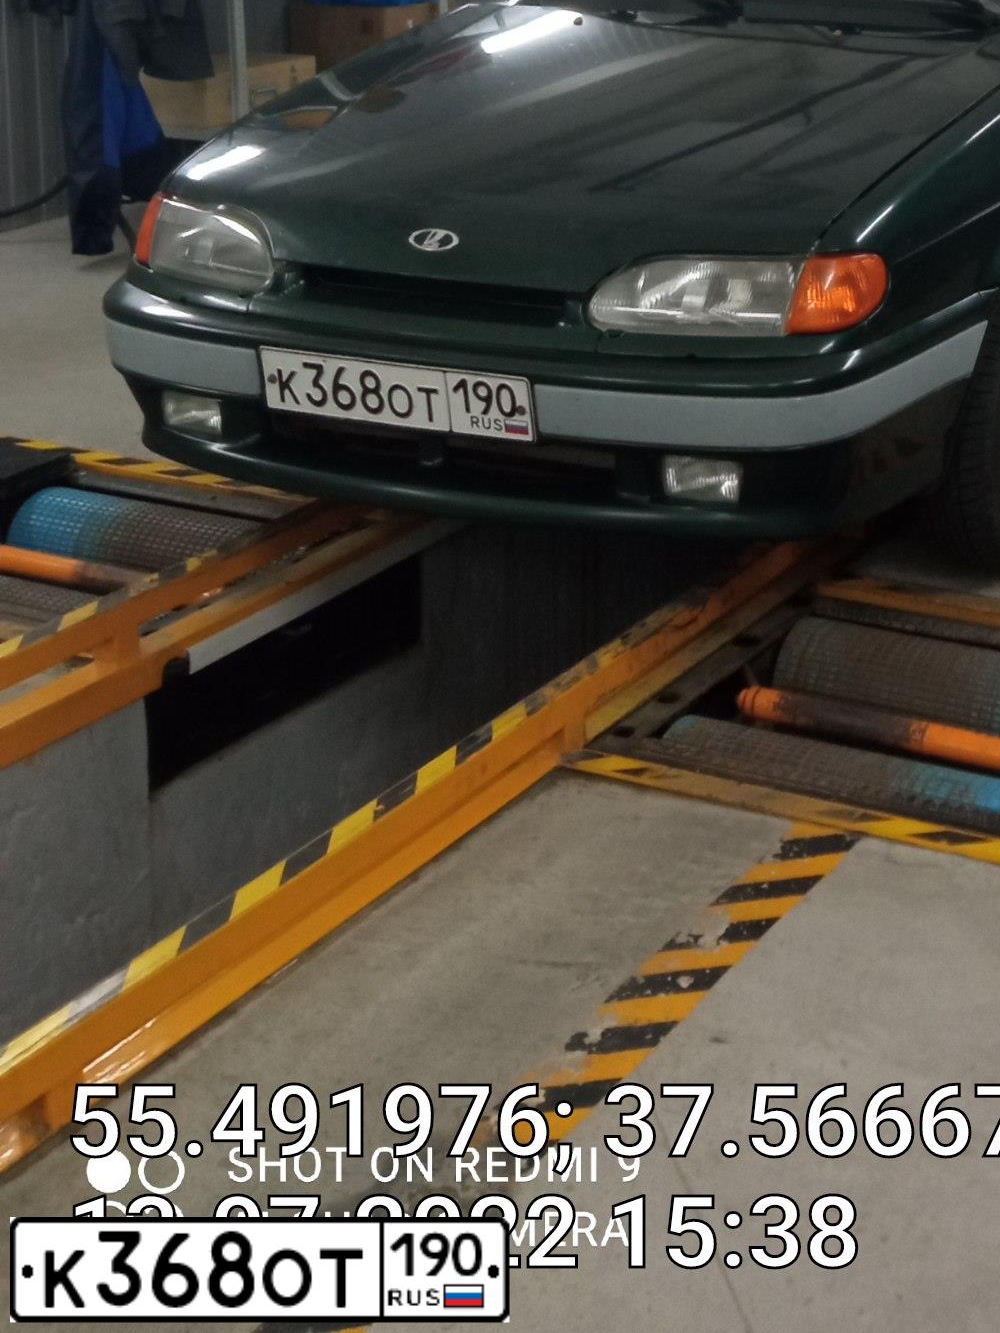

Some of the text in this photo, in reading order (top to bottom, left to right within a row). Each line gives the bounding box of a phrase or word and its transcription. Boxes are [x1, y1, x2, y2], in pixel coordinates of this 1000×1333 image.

[276, 362, 518, 422] К368ОТ 190
[469, 417, 503, 432] RUS
